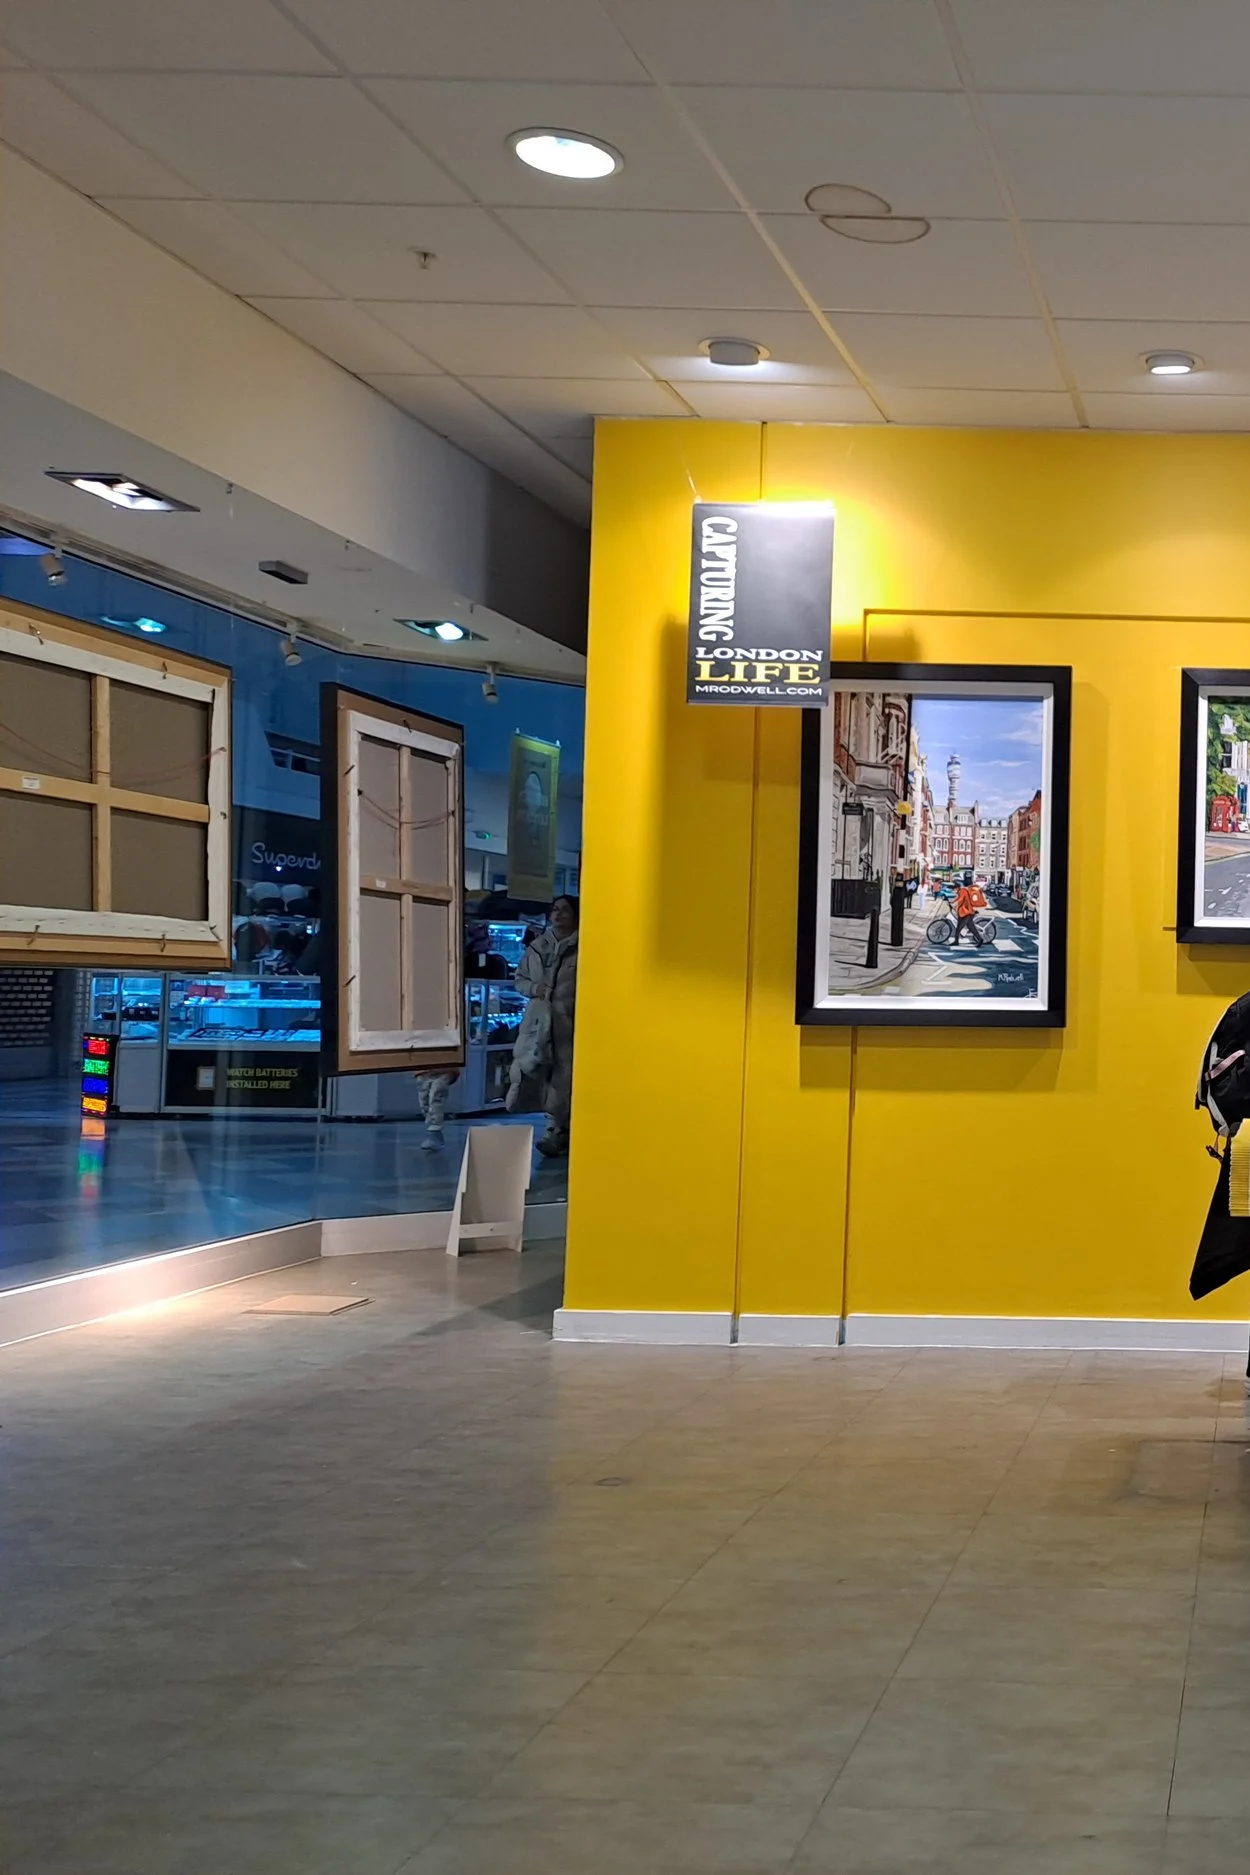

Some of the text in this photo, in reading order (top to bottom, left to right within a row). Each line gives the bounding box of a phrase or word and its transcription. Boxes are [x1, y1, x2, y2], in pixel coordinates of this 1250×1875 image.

[699, 516, 738, 641] CAPTURING
[695, 647, 823, 661] LONDON
[695, 661, 821, 684] LIFE
[695, 685, 822, 696] MRODWELL.COM
[226, 1068, 298, 1077] WATCH BATTERIES
[226, 1080, 291, 1089] INSTALLED HERE
